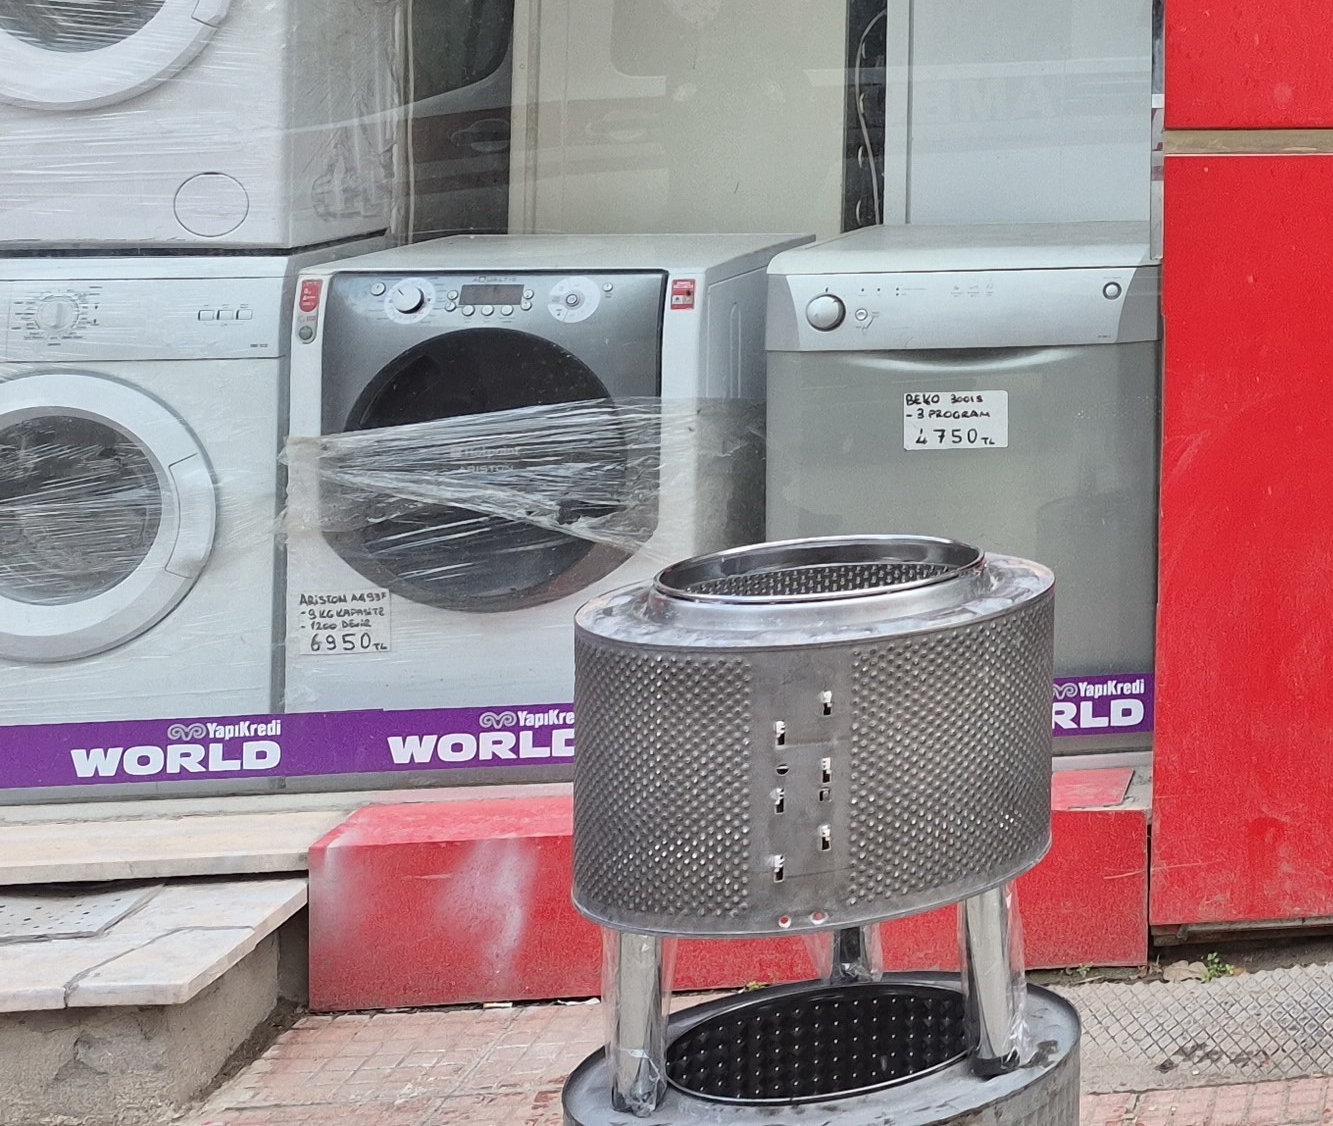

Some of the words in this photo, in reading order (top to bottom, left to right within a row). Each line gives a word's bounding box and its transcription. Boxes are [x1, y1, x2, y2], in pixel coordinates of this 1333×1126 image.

[905, 393, 940, 405] BEKO
[928, 409, 991, 419] PROGRAM
[1078, 679, 1145, 699] YapıKredi
[517, 710, 574, 729] YapıKre
[1052, 699, 1145, 729] RLD
[206, 720, 282, 740] YapıKredi
[70, 741, 281, 778] WORLD
